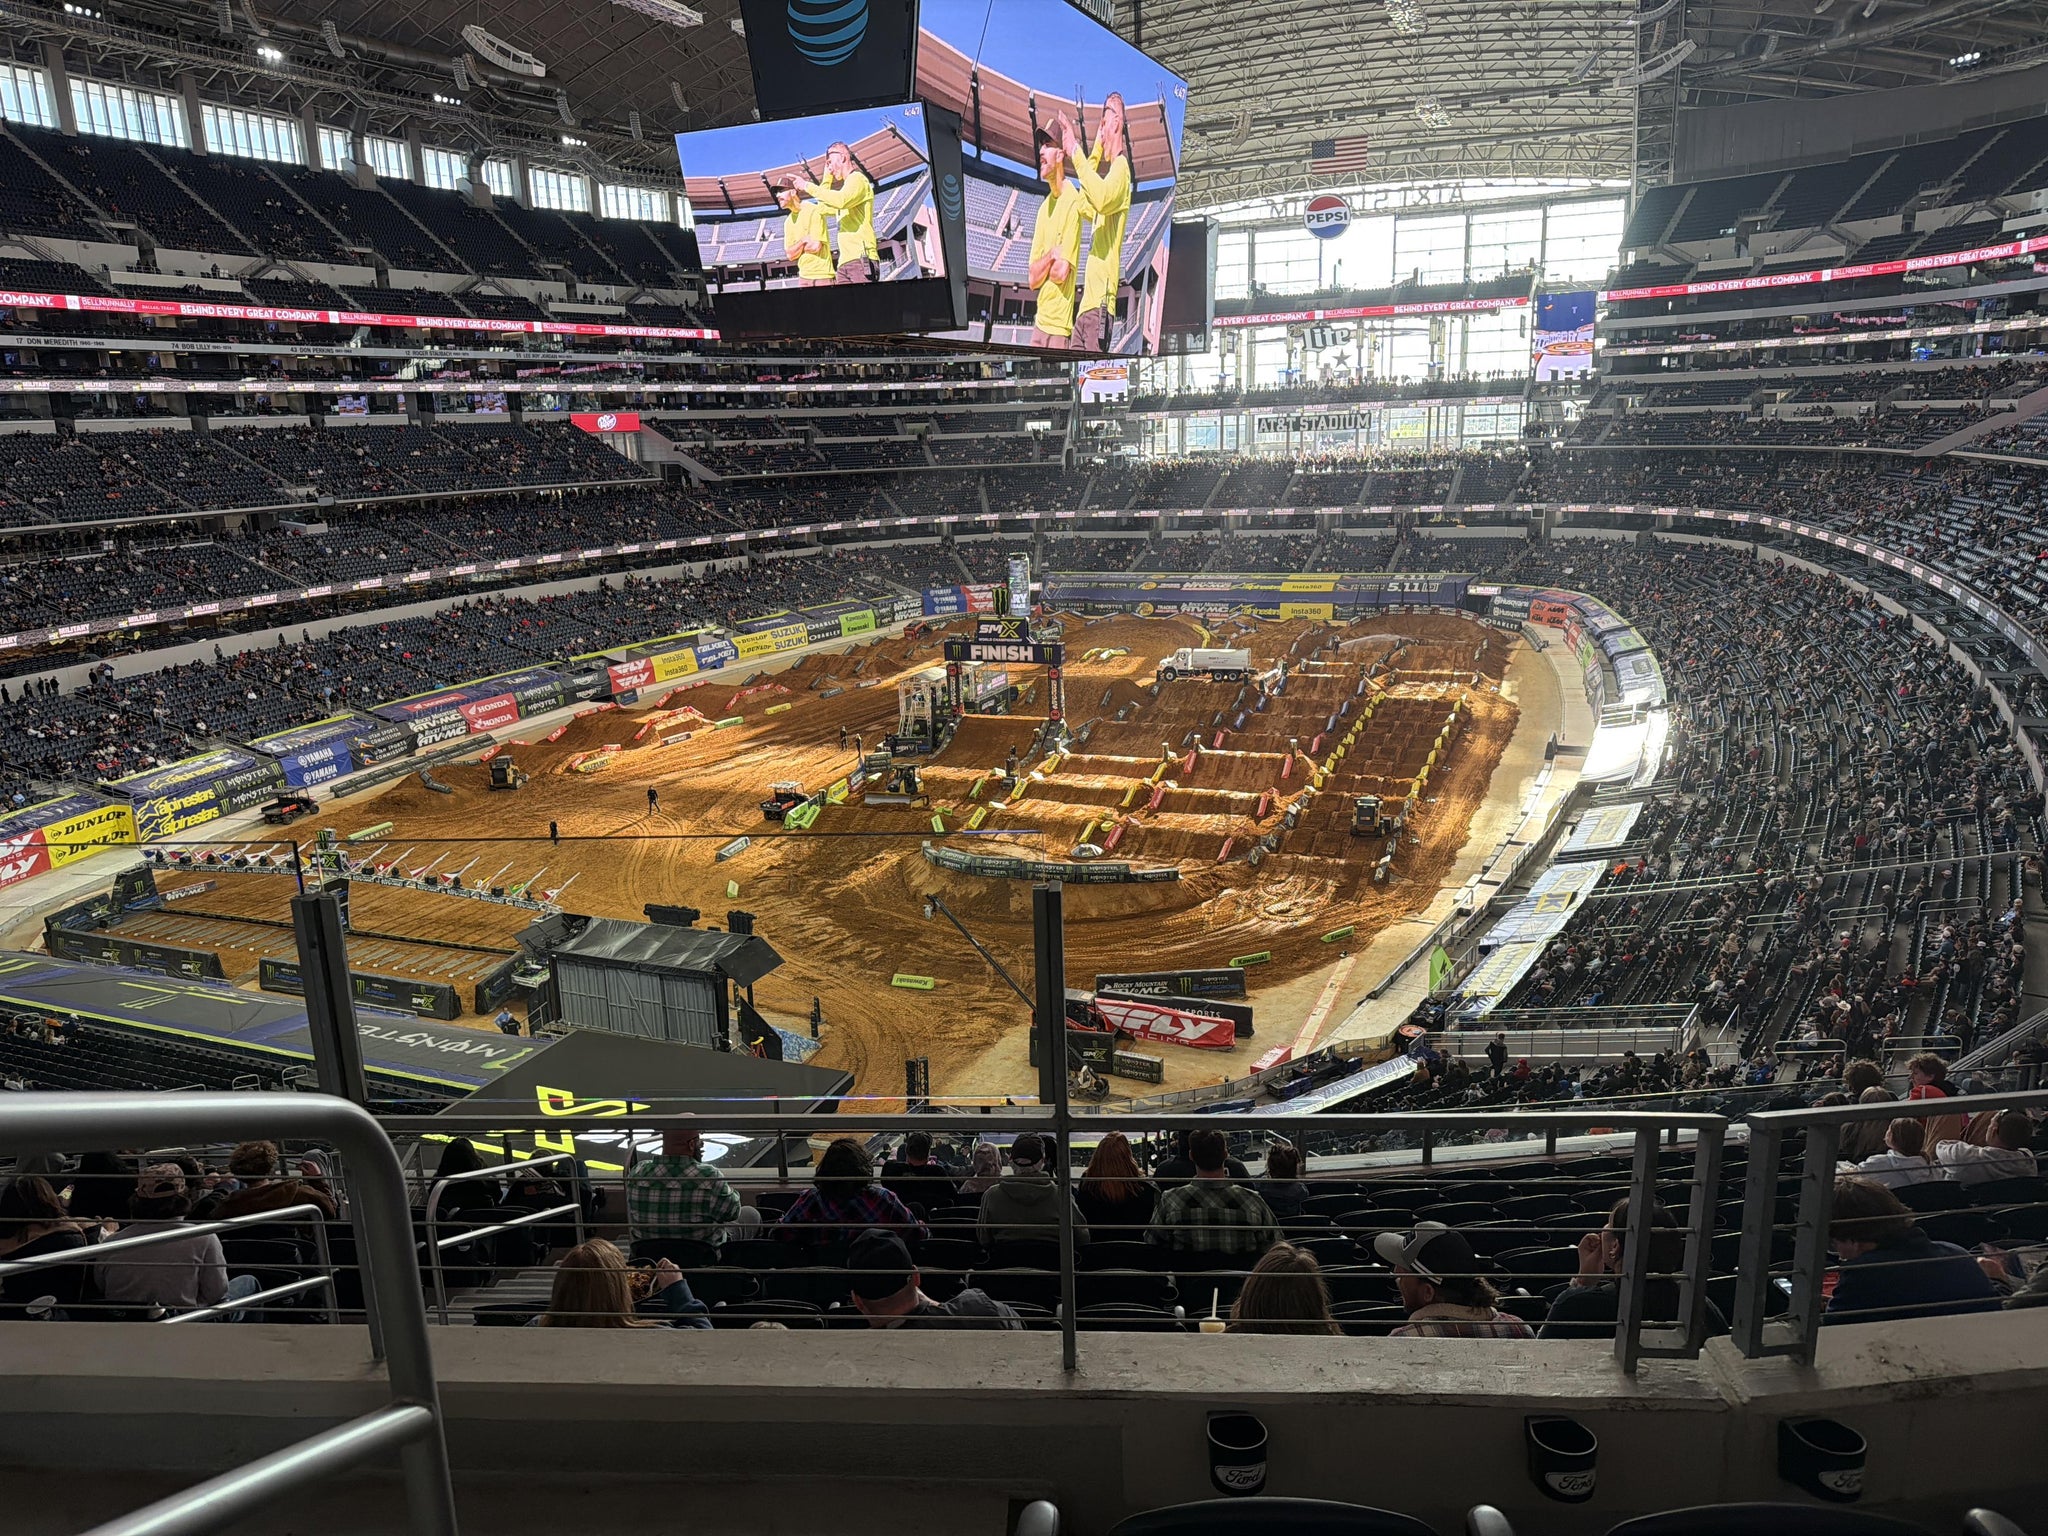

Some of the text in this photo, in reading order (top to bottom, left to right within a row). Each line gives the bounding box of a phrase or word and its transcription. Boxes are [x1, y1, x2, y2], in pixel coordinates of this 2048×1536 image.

[904, 107, 919, 117] 4:47
[1307, 211, 1348, 224] PEPSI
[1688, 283, 1716, 293] BEHIND
[1718, 281, 1743, 291] EVERY
[1746, 278, 1769, 288] GREAT
[1772, 274, 1812, 285] COMPANY.
[1907, 259, 1933, 269] BEHIND
[1934, 255, 1957, 265] EVERY
[1959, 251, 1978, 262] GREAT
[1980, 246, 2013, 258] COMPANY.
[1223, 316, 1245, 325] EVERY
[1247, 315, 1269, 324] GREAT
[1270, 312, 1308, 322] COMPANY.
[1394, 304, 1421, 314] BEHIND
[1423, 303, 1448, 312] EVERY
[1450, 301, 1475, 310] GREAT
[1477, 299, 1517, 308] COMPANY.
[180, 305, 215, 316] BEHIND
[216, 307, 243, 318] EVERY
[246, 309, 273, 318] GREAT
[276, 310, 320, 321] COMPANY.
[416, 317, 443, 327] BEHIND
[445, 319, 466, 328] EVERY
[468, 320, 489, 329] GREAT
[491, 321, 526, 330] COMPANY.
[605, 326, 627, 335] BEHIND
[628, 327, 646, 336] EVERY
[648, 328, 667, 337] GREAT
[44, 338, 78, 346] MEREDITH
[1302, 326, 1351, 352] Lite
[23, 381, 49, 389] MILITARY
[1417, 399, 1443, 407] MILITARY
[1476, 396, 1503, 404] MILITARY
[1258, 414, 1370, 433] AT&T STADIUM
[1387, 582, 1420, 592] 5.11
[252, 594, 277, 602] MILITARY
[192, 603, 220, 613] MILITARY
[128, 613, 157, 624] MILITARY
[58, 624, 90, 635] MILITARY
[770, 624, 805, 639] SUZUKI
[847, 624, 870, 632] Kawasaki
[979, 621, 1019, 638] SMX
[741, 634, 767, 644] DUNLOP
[775, 636, 806, 650] SUZUKI
[698, 640, 729, 653] FALKEN
[970, 645, 1034, 661] FINISH
[662, 653, 685, 664] Insta360
[702, 650, 735, 664] FALKEN
[665, 666, 688, 677] Insta360
[478, 699, 511, 713] HONDA
[482, 713, 513, 727] HONDA
[371, 732, 402, 745] COMMISSION
[381, 727, 399, 736] SPORTS
[388, 740, 407, 751] SPORTS
[305, 747, 334, 763] YAMAHA
[376, 746, 408, 761] COMMISSION
[226, 768, 270, 787] MONSTER
[311, 764, 338, 780] YAMAHA
[159, 788, 216, 816] alpinestars
[232, 785, 273, 805] MONSTER
[64, 811, 126, 836] DUNLOP
[164, 806, 220, 835] alpinestars
[0, 832, 35, 858] LY
[68, 830, 130, 856] DUNLOP
[311, 855, 337, 869] SMX
[1237, 952, 1268, 965] Kawasaki
[896, 977, 928, 986] Kawasaki
[1113, 980, 1168, 989] ROCKY MOUNTAIN
[412, 996, 434, 1010] SMX
[1185, 1008, 1221, 1018] SPORTS
[1097, 1004, 1219, 1040] FLY
[357, 1022, 507, 1058] MONSTE
[1083, 1050, 1108, 1061] SMX
[1122, 1058, 1150, 1067] MONSTER
[1122, 1069, 1150, 1080] MONSTER
[1226, 1469, 1261, 1485] Ford
[1559, 1475, 1593, 1491] Ford
